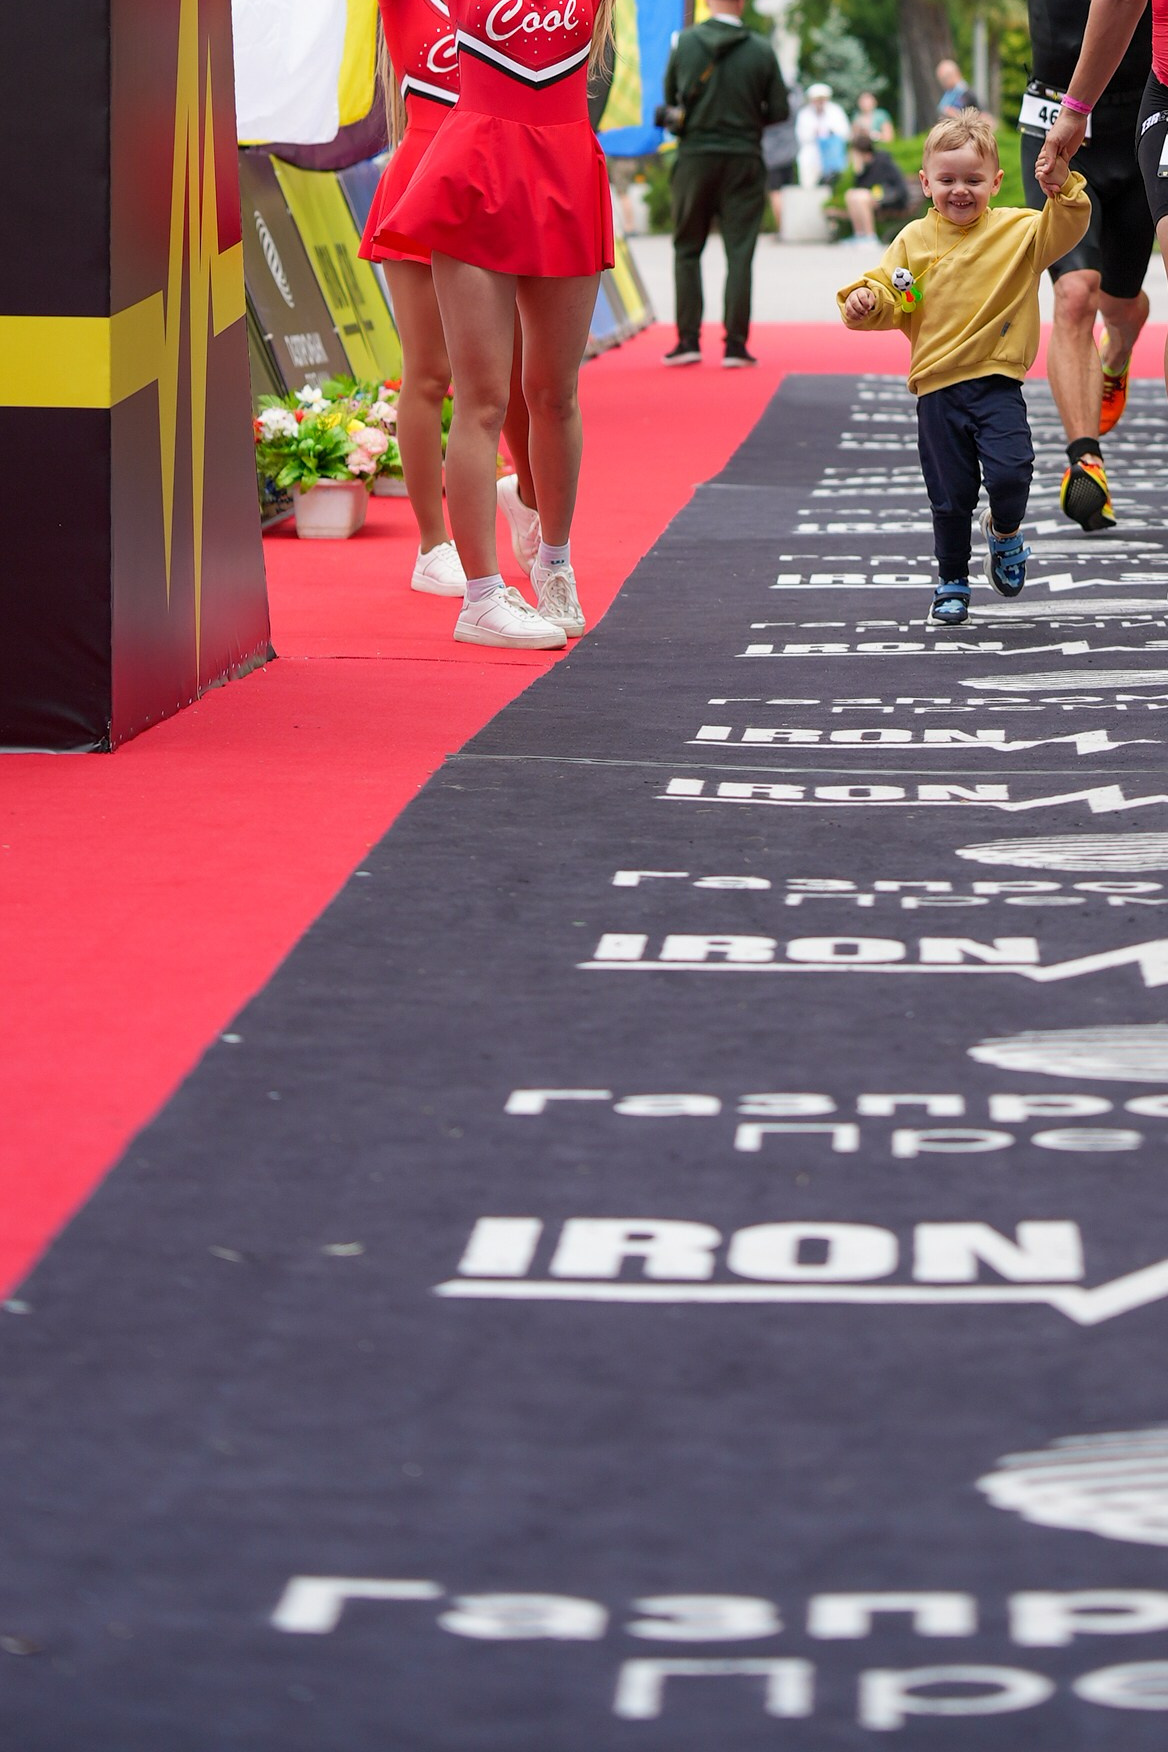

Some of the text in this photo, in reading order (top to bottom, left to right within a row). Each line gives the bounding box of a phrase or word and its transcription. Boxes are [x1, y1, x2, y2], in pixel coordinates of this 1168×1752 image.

[745, 642, 1004, 655] IRON
[695, 725, 1006, 743] IRON
[665, 777, 1010, 801] IRON
[593, 933, 1041, 964] IRON
[457, 1216, 1084, 1283] IRON
